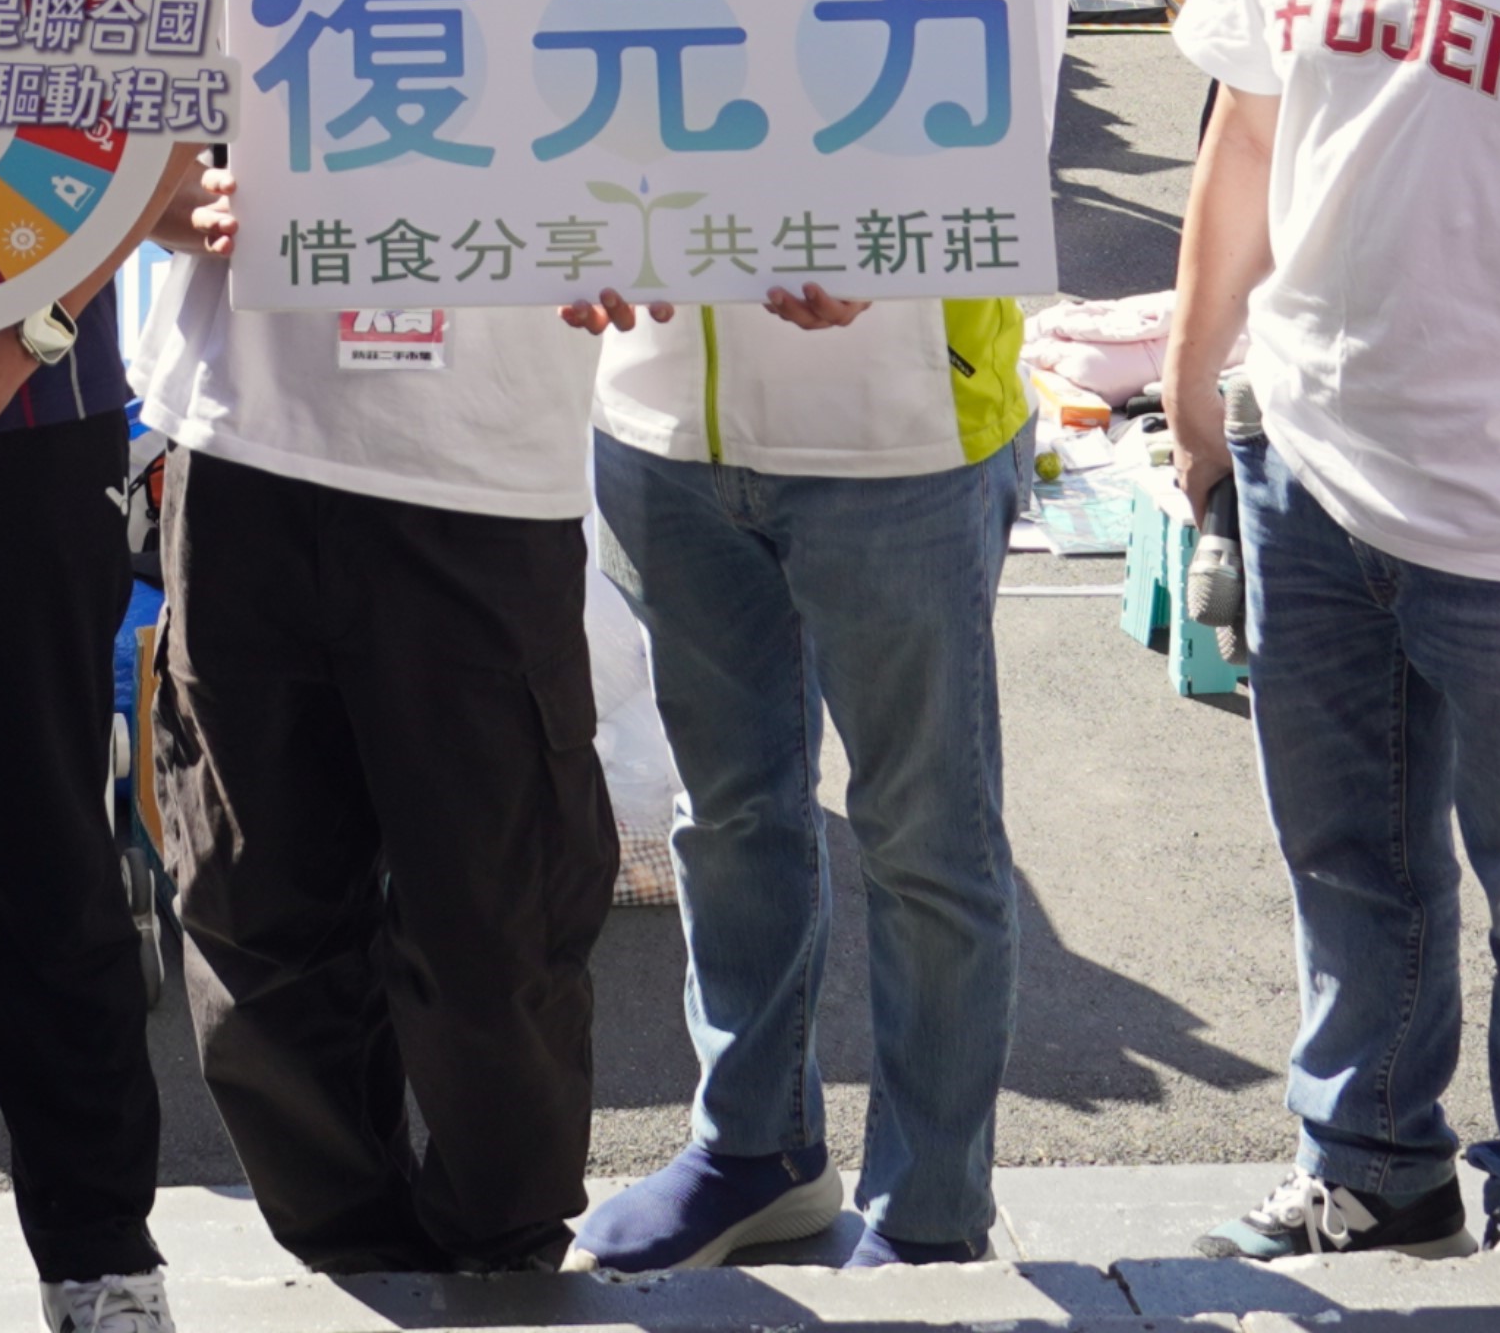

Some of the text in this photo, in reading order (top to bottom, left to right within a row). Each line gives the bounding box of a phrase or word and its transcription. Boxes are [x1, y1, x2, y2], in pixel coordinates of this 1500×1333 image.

[278, 206, 1021, 287] 惜食分享 共生新莊
